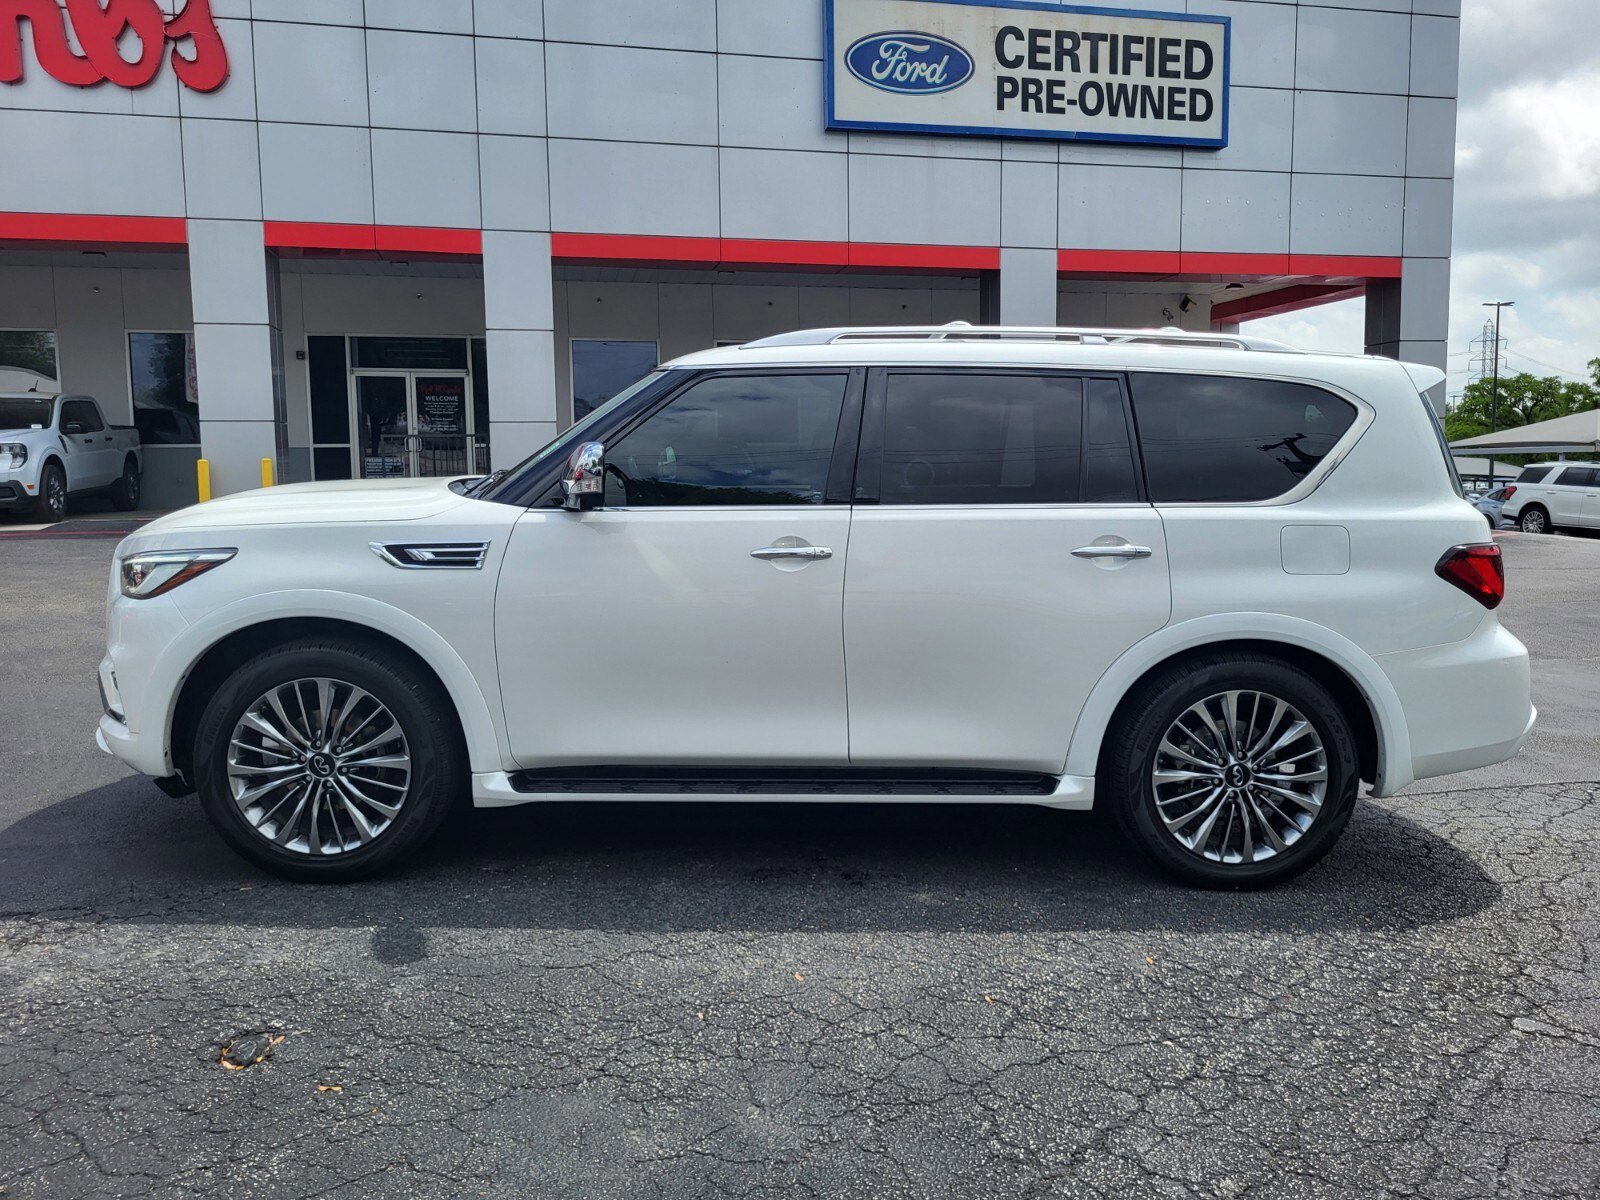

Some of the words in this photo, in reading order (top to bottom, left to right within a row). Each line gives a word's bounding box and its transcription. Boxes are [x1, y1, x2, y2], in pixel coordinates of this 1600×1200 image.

[872, 40, 948, 85] Ford
[995, 25, 1213, 80] CERTIFIED
[996, 76, 1213, 122] PRE-OWNED
